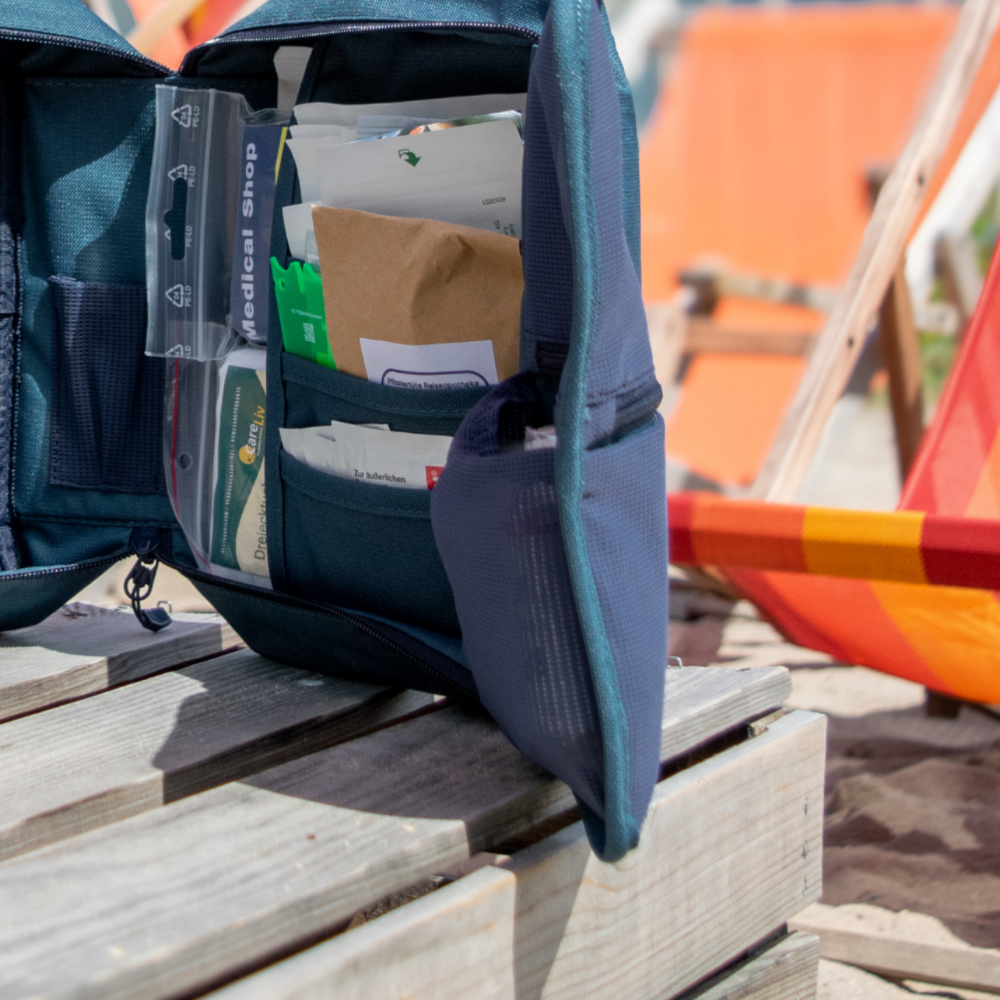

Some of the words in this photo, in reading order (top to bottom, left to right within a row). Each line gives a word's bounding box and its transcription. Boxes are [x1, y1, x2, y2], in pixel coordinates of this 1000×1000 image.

[192, 105, 200, 128] PE-LD
[188, 165, 196, 188] PE-LD
[242, 143, 258, 218] Shop
[185, 225, 193, 248] PE-LD
[241, 229, 256, 340] Medical
[354, 469, 365, 478] Zur
[366, 471, 406, 483] äußerlichen
